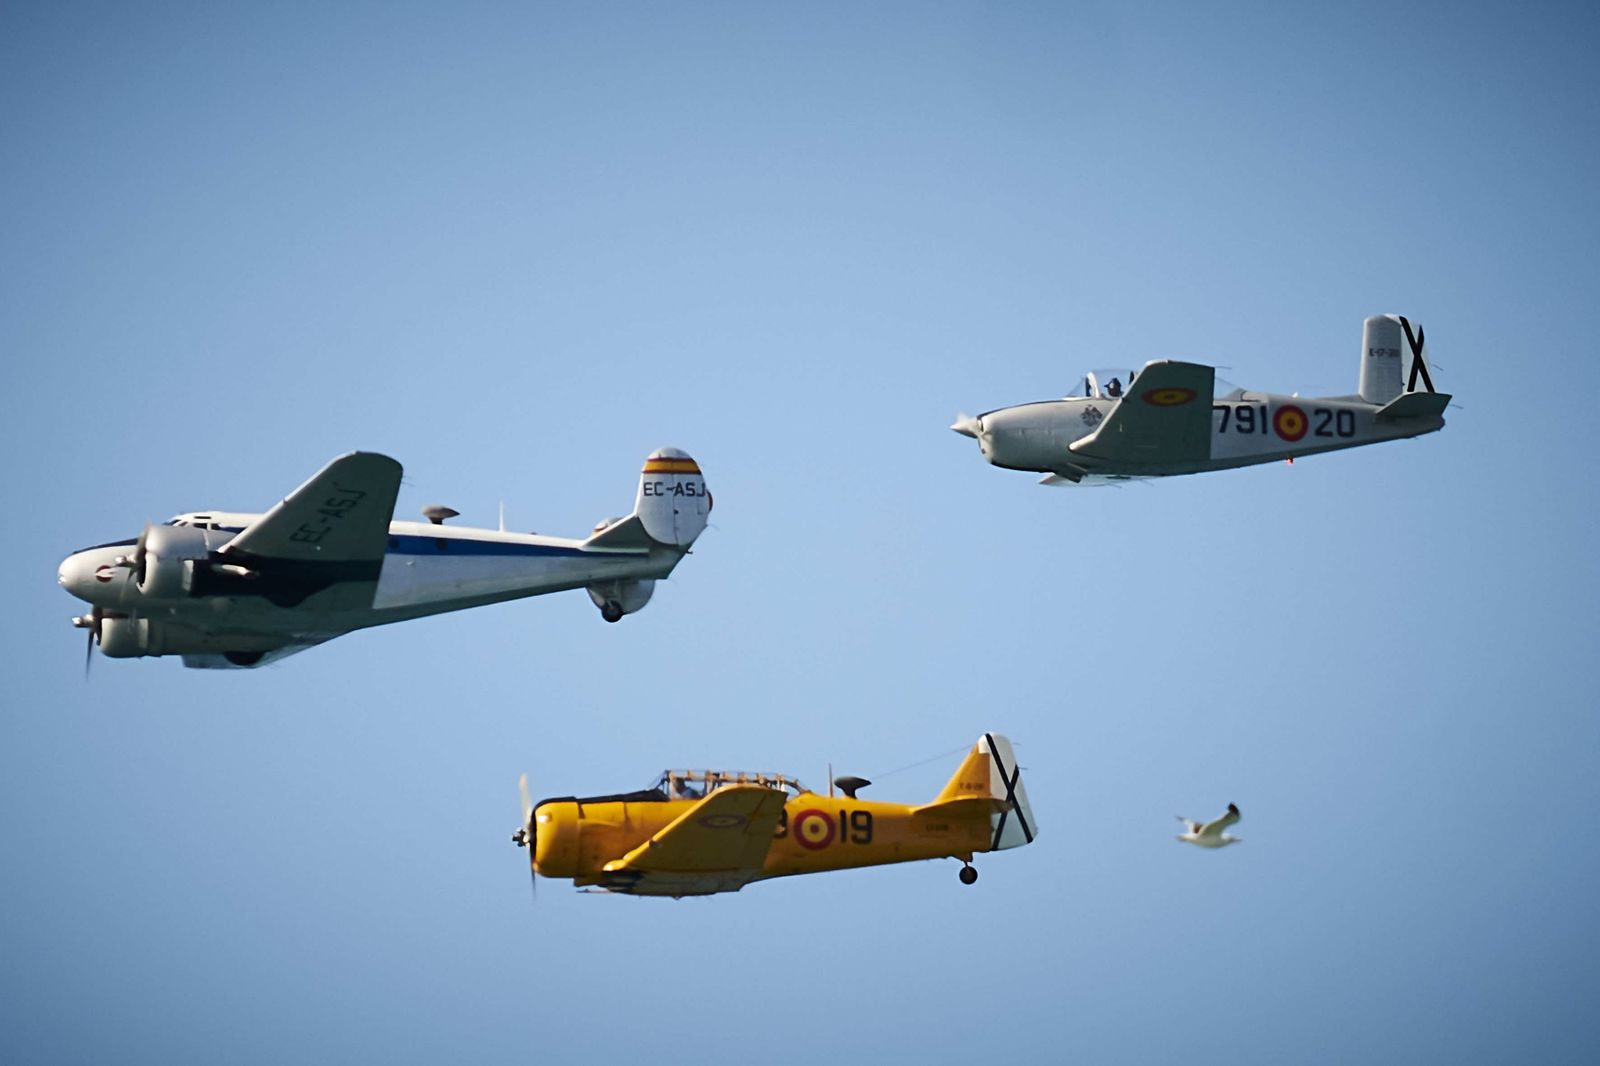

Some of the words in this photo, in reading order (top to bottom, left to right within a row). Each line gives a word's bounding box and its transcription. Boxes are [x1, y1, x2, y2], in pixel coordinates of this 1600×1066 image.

[1212, 405, 1268, 434] 791
[1313, 408, 1356, 437] 20
[643, 481, 706, 498] EC-ASJ
[288, 488, 368, 543] EC-ASJ
[839, 809, 873, 844] 19
